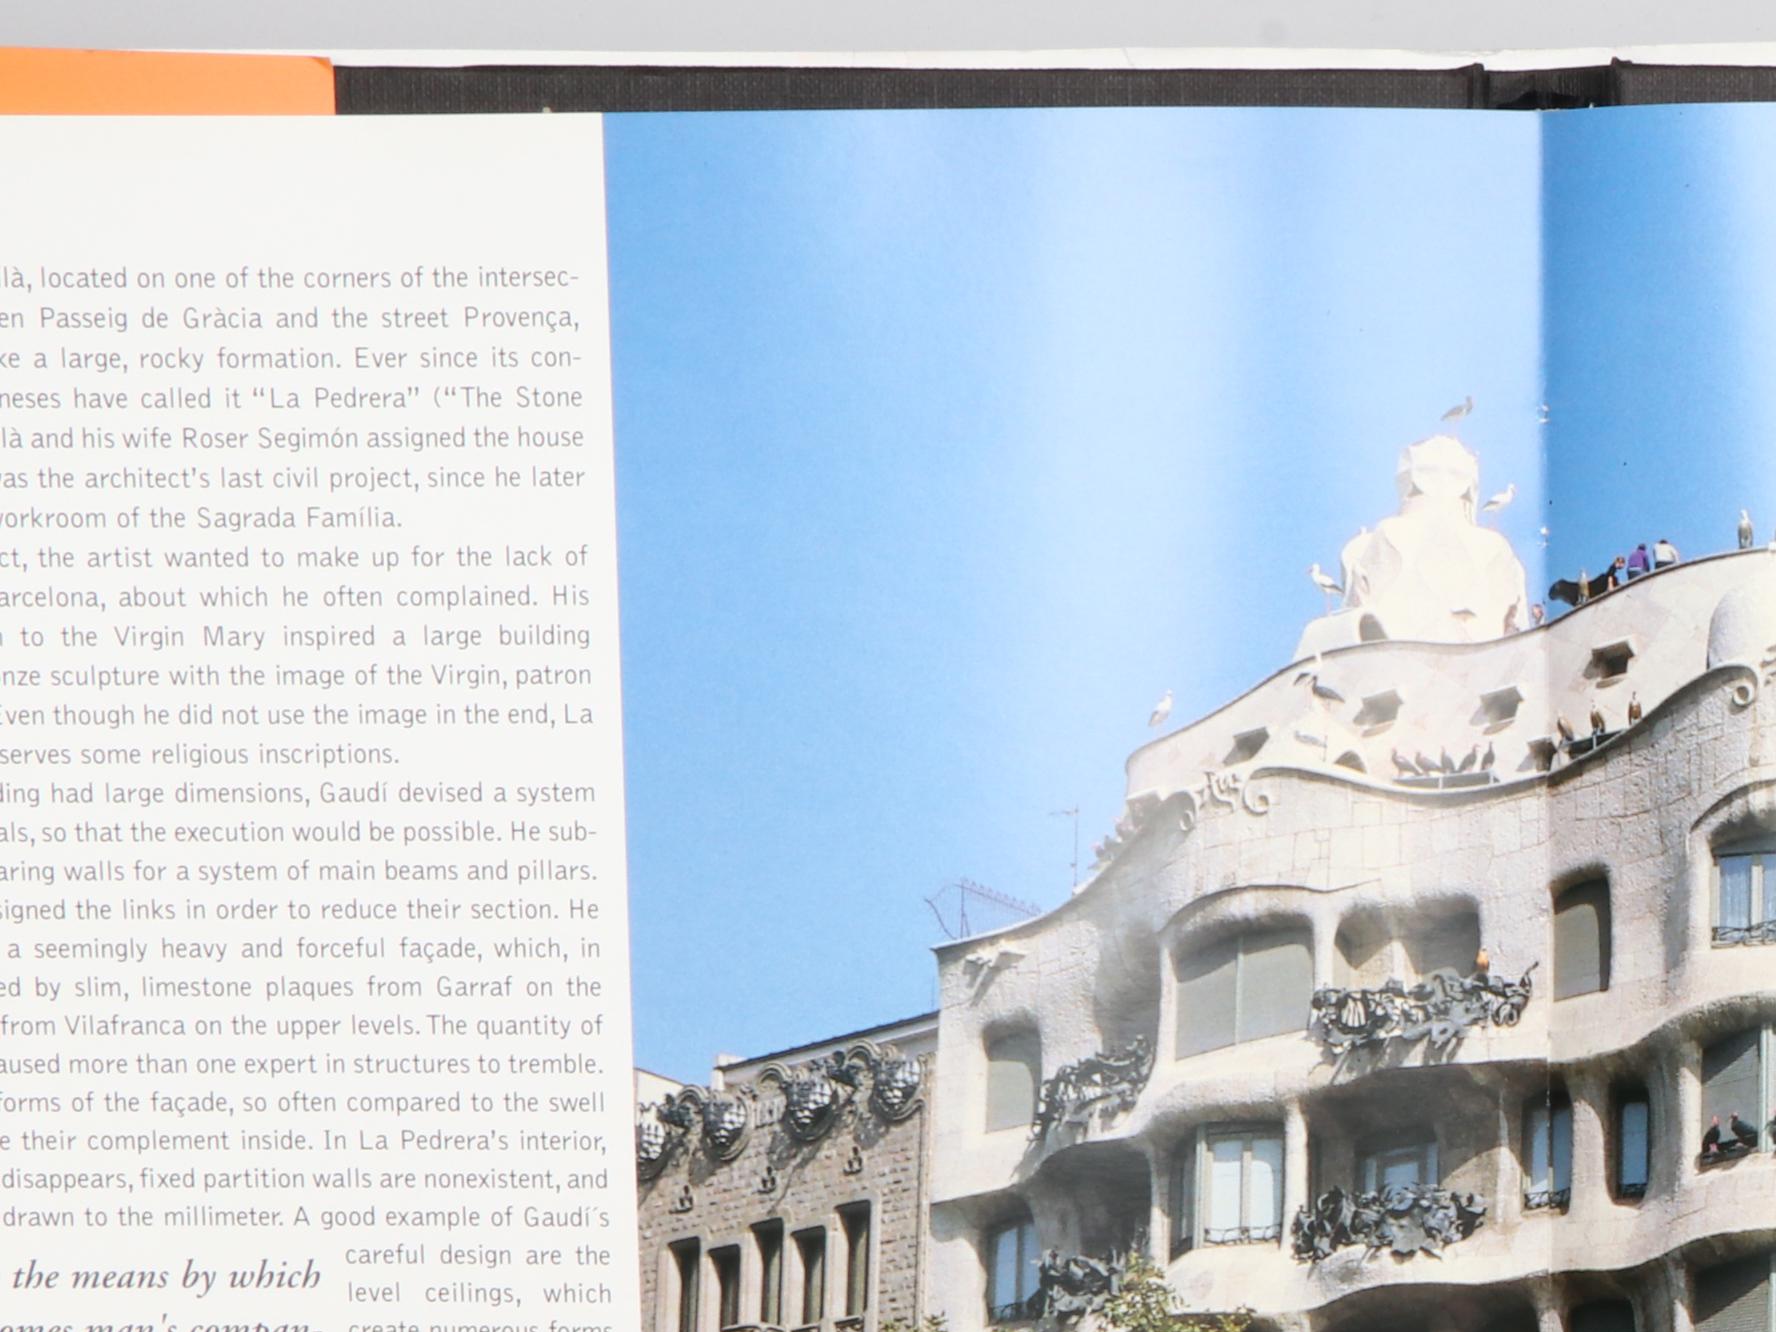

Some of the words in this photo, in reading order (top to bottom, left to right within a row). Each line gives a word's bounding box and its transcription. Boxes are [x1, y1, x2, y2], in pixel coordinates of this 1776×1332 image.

[40, 266, 128, 289] located
[136, 271, 165, 289] on
[174, 271, 216, 289] one
[225, 265, 249, 289] of
[257, 266, 294, 289] the
[303, 271, 392, 289] corners
[400, 265, 424, 288] of
[431, 265, 469, 289] the
[478, 265, 579, 288] intersec-
[73, 387, 128, 409] have
[140, 387, 211, 409] called
[225, 387, 242, 409] it
[516, 385, 583, 409] Stone
[37, 466, 75, 489] the
[220, 466, 264, 489] last
[272, 466, 318, 489] civil
[329, 466, 420, 493] project,
[427, 466, 485, 488] since
[495, 465, 521, 488] he
[532, 465, 586, 488] later
[20, 627, 44, 647] to
[60, 625, 98, 647] the
[113, 625, 184, 651] Virgin
[203, 625, 265, 651] Mary
[283, 624, 375, 651] inspired
[392, 629, 406, 647] a
[423, 624, 482, 650] large
[499, 623, 590, 650] building
[80, 748, 141, 765] some
[152, 743, 249, 769] religious
[259, 742, 399, 769] inscriptions.
[7, 942, 21, 959] a
[34, 937, 148, 963] seemingly
[161, 937, 228, 963] heavy
[241, 936, 283, 959] and
[296, 936, 385, 959] forceful
[399, 936, 483, 964] façade,
[493, 936, 568, 963] which,
[581, 937, 600, 958] in
[0, 1014, 56, 1036] from
[64, 1013, 186, 1036] Vilafranca
[194, 1019, 222, 1036] on
[231, 1014, 267, 1036] the
[276, 1019, 342, 1040] upper
[351, 1014, 421, 1036] levels.
[426, 1014, 468, 1036] The
[476, 1014, 571, 1040] quantity
[580, 1013, 603, 1036] of
[1, 1167, 134, 1193] disappears,
[139, 1167, 195, 1189] fixed
[203, 1167, 305, 1193] partition
[312, 1167, 373, 1189] walls
[379, 1172, 417, 1189] are
[424, 1168, 561, 1194] nonexistent,
[567, 1167, 608, 1190] and
[2, 1205, 74, 1227] drawn
[84, 1207, 108, 1227] to
[117, 1205, 154, 1227] the
[164, 1205, 284, 1227] millimeter.
[293, 1205, 311, 1226] A
[320, 1205, 376, 1231] good
[385, 1205, 481, 1232] example
[490, 1205, 513, 1227] of
[345, 1242, 425, 1265] careful
[439, 1243, 512, 1269] design
[525, 1249, 562, 1266] are
[575, 1244, 611, 1266] the
[12, 1258, 60, 1290] the
[71, 1270, 170, 1289] means
[181, 1257, 217, 1299] by
[229, 1258, 321, 1289] which
[348, 1281, 400, 1303] level
[425, 1282, 521, 1308] ceilings,
[543, 1282, 612, 1304] which
